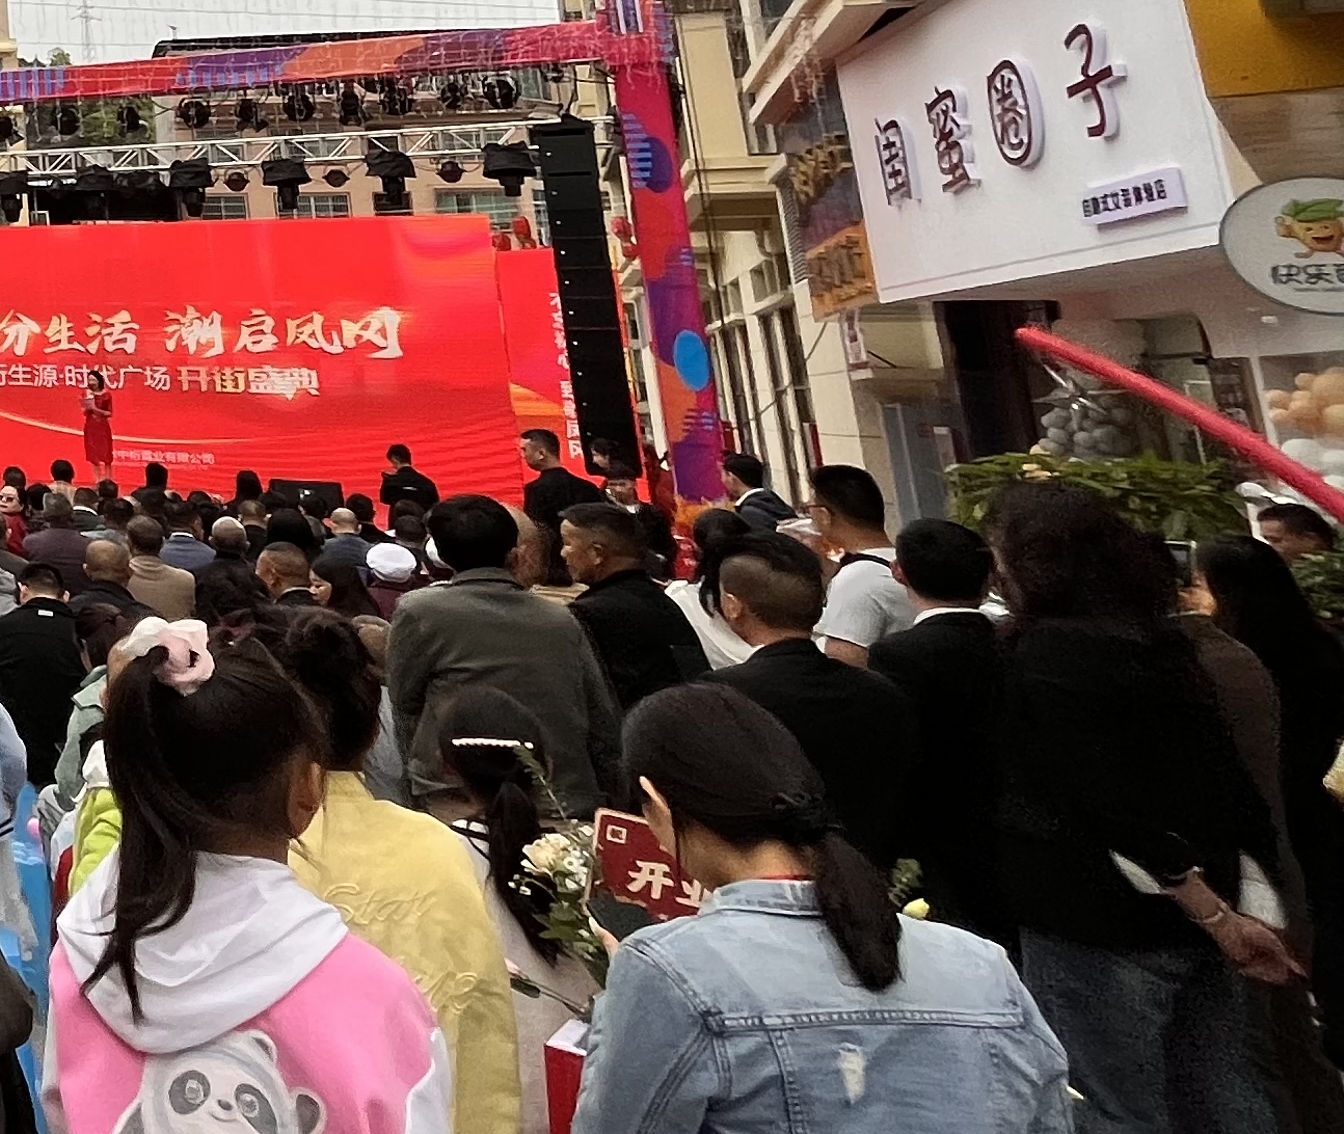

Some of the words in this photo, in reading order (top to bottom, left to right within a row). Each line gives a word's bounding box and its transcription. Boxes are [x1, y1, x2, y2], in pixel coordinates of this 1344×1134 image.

[874, 23, 1113, 207] 闺蜜圈子
[177, 364, 321, 400] 开街盛典
